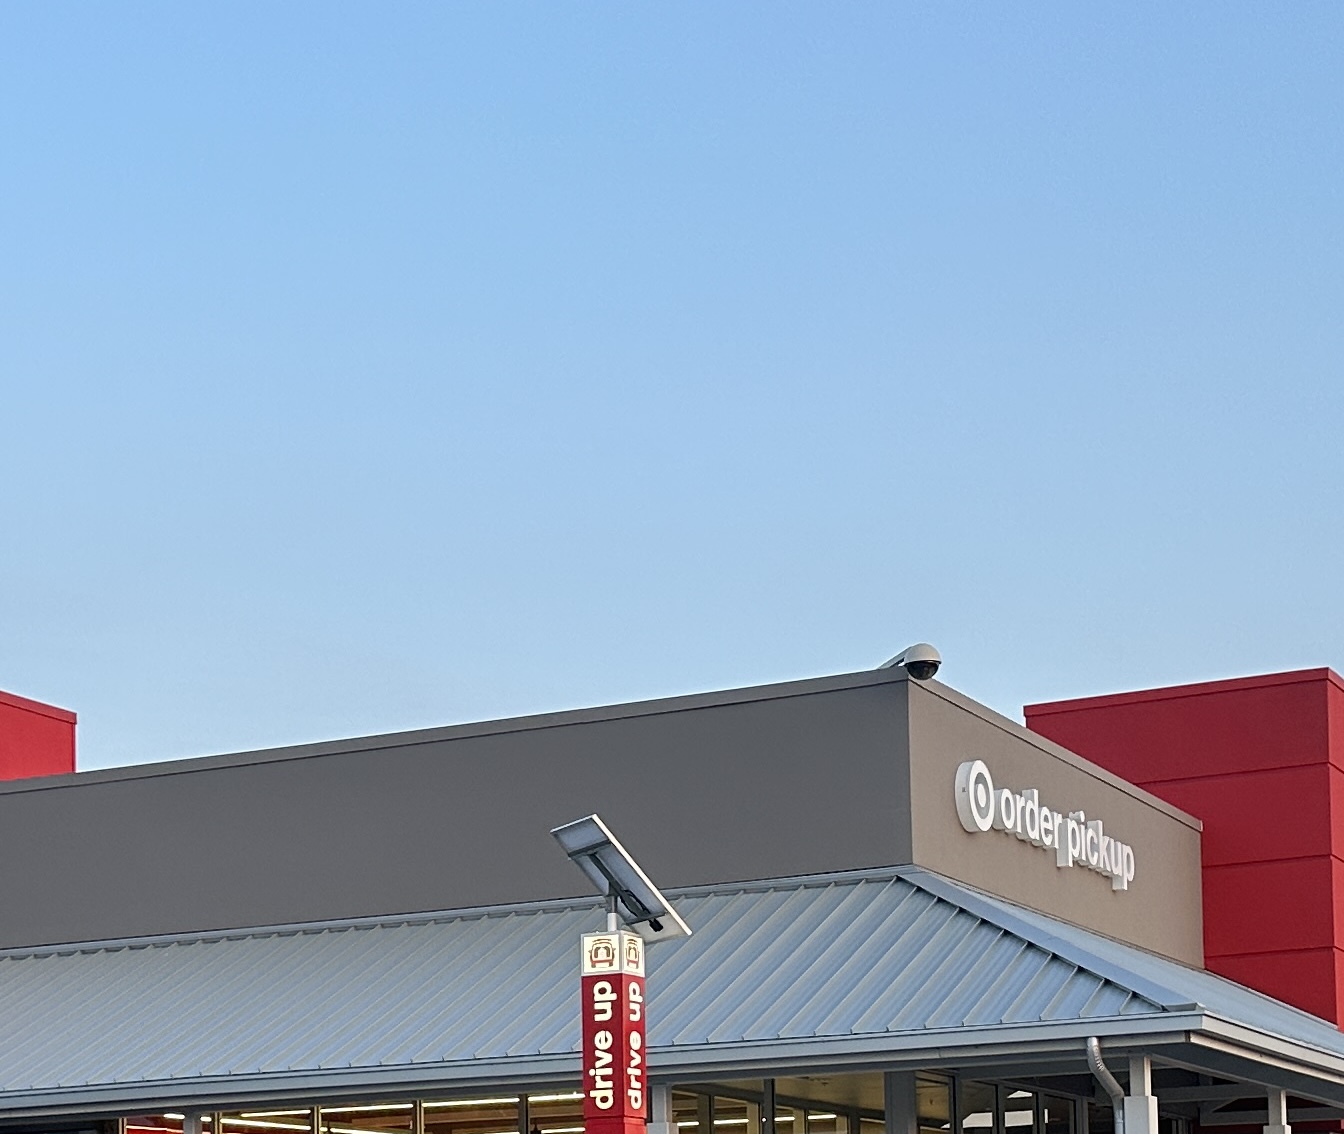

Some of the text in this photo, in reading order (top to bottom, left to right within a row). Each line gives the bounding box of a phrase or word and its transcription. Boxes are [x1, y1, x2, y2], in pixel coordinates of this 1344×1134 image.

[992, 788, 1135, 890] order pickup
[589, 980, 617, 1110] drive up
[625, 981, 643, 1110] drive up
